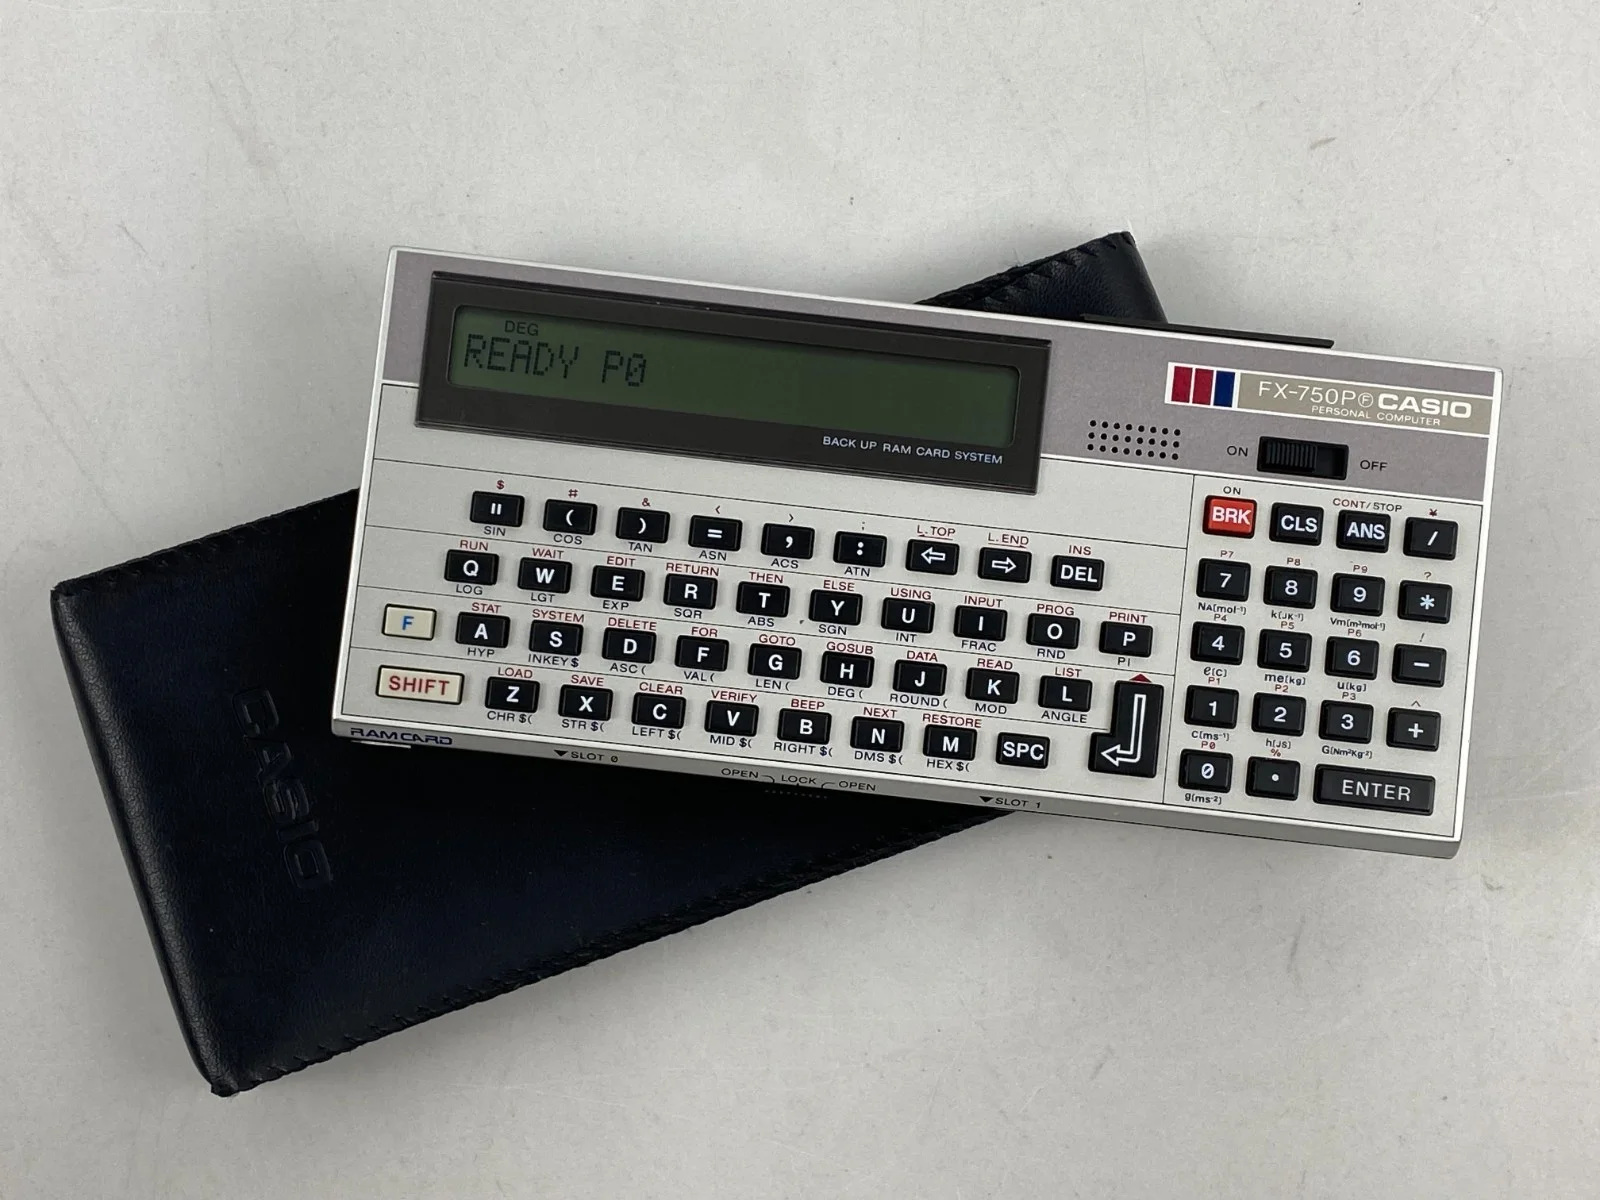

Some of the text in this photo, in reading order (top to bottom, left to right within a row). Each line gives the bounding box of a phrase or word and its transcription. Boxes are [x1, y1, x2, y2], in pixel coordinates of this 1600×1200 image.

[504, 320, 539, 337] DEG
[464, 333, 647, 387] READY P0
[1377, 393, 1472, 419] CASIO
[1311, 405, 1441, 426] PERSONAL COMPUTER
[823, 436, 1002, 464] BACK UP RAM CARD SYSTEM
[1226, 445, 1248, 457] ON
[1360, 459, 1388, 472] OFF
[496, 479, 505, 490] $
[1223, 485, 1241, 495] ON
[568, 489, 579, 498] #
[641, 497, 651, 507] &
[1212, 507, 1251, 525] BRK
[1281, 515, 1317, 533] CLS
[483, 525, 506, 537] SIN
[1346, 522, 1385, 540] ANS
[459, 539, 489, 551] RUN
[553, 533, 583, 545] COS
[532, 547, 565, 559] WAIT
[627, 541, 653, 553] TAN
[1068, 544, 1091, 556] INS
[606, 555, 636, 567] EDIT
[698, 550, 727, 561] ASN
[1220, 550, 1234, 559] P7
[770, 558, 799, 569] ACS
[1286, 557, 1301, 566] P8
[463, 560, 479, 577] Q
[665, 562, 719, 577] RETURN
[843, 566, 871, 577] ATN
[1060, 564, 1098, 583] DEL
[1353, 564, 1368, 574] P9
[536, 567, 555, 584] W
[748, 571, 784, 584] THEN
[1220, 572, 1232, 588] 7
[612, 575, 625, 591] E
[823, 579, 855, 592] ELSE
[1285, 580, 1298, 595] 8
[455, 584, 483, 596] LOG
[684, 583, 698, 600] R
[890, 587, 931, 600] USING
[1353, 587, 1366, 602] 9
[530, 592, 556, 603] LGT
[758, 592, 771, 608] T
[964, 595, 1003, 608] INPUT
[471, 602, 502, 614] STAT
[602, 599, 629, 611] EXP
[831, 600, 845, 616] Y
[1036, 603, 1074, 616] PROG
[532, 608, 585, 623] SYSTEM
[673, 607, 703, 619] SQR
[902, 607, 915, 624] U
[1108, 611, 1148, 624] PRINT
[1213, 613, 1227, 622] P4
[402, 615, 415, 631] F
[608, 617, 657, 631] DELETE
[747, 616, 775, 627] ABS
[1280, 620, 1295, 630] P5
[474, 623, 488, 640] A
[691, 626, 718, 638] FOR
[818, 623, 848, 636] SGN
[1047, 623, 1063, 640] O
[1347, 628, 1362, 637] P6
[549, 631, 563, 648] S
[758, 634, 796, 646] GOTO
[896, 632, 918, 643] INT
[1123, 631, 1136, 646] P
[1211, 635, 1225, 651] 4
[623, 638, 637, 654] D
[826, 641, 874, 655] GOSUB
[961, 639, 997, 652] FRAC
[1279, 642, 1292, 658] 5
[467, 647, 495, 658] HYP
[697, 646, 710, 662] F
[906, 650, 938, 662] DATA
[1037, 648, 1066, 660] RND
[1347, 650, 1360, 666] 6
[768, 654, 783, 671] G
[977, 658, 1013, 670] READ
[1117, 656, 1131, 667] PI
[497, 666, 533, 679] LOAD
[840, 663, 854, 680] H
[1055, 666, 1083, 678] LIST
[388, 674, 450, 696] SHIFT
[570, 674, 604, 687] SAVE
[914, 671, 926, 687] J
[1208, 676, 1220, 685] P1
[639, 681, 683, 695] CLEAR
[987, 679, 1002, 696] K
[1062, 686, 1073, 702] L
[1274, 684, 1289, 693] P2
[506, 686, 520, 703] Z
[711, 689, 758, 703] VERIFY
[1342, 691, 1356, 701] P3
[579, 695, 594, 712] X
[790, 698, 825, 710] BEEP
[974, 702, 1007, 715] MOD
[1209, 701, 1217, 716] 1
[653, 703, 667, 720] C
[727, 710, 740, 726] V
[863, 706, 898, 719] NEXT
[1040, 710, 1088, 724] ANGLE
[1274, 706, 1287, 722] 2
[799, 719, 813, 735] B
[922, 713, 982, 729] RESTORE
[1341, 714, 1354, 730] 3
[871, 728, 885, 744] N
[942, 736, 959, 753] M
[1002, 741, 1044, 760] SPC
[1201, 740, 1216, 750] P0
[570, 750, 605, 761] SLOT
[1270, 748, 1281, 757] %
[720, 767, 760, 779] OPEN
[780, 774, 817, 785] LOCK
[232, 686, 334, 888] CASIO
[838, 780, 877, 792] OPEN
[1342, 779, 1410, 802] ENTER
[994, 796, 1041, 809] SLOT 1
